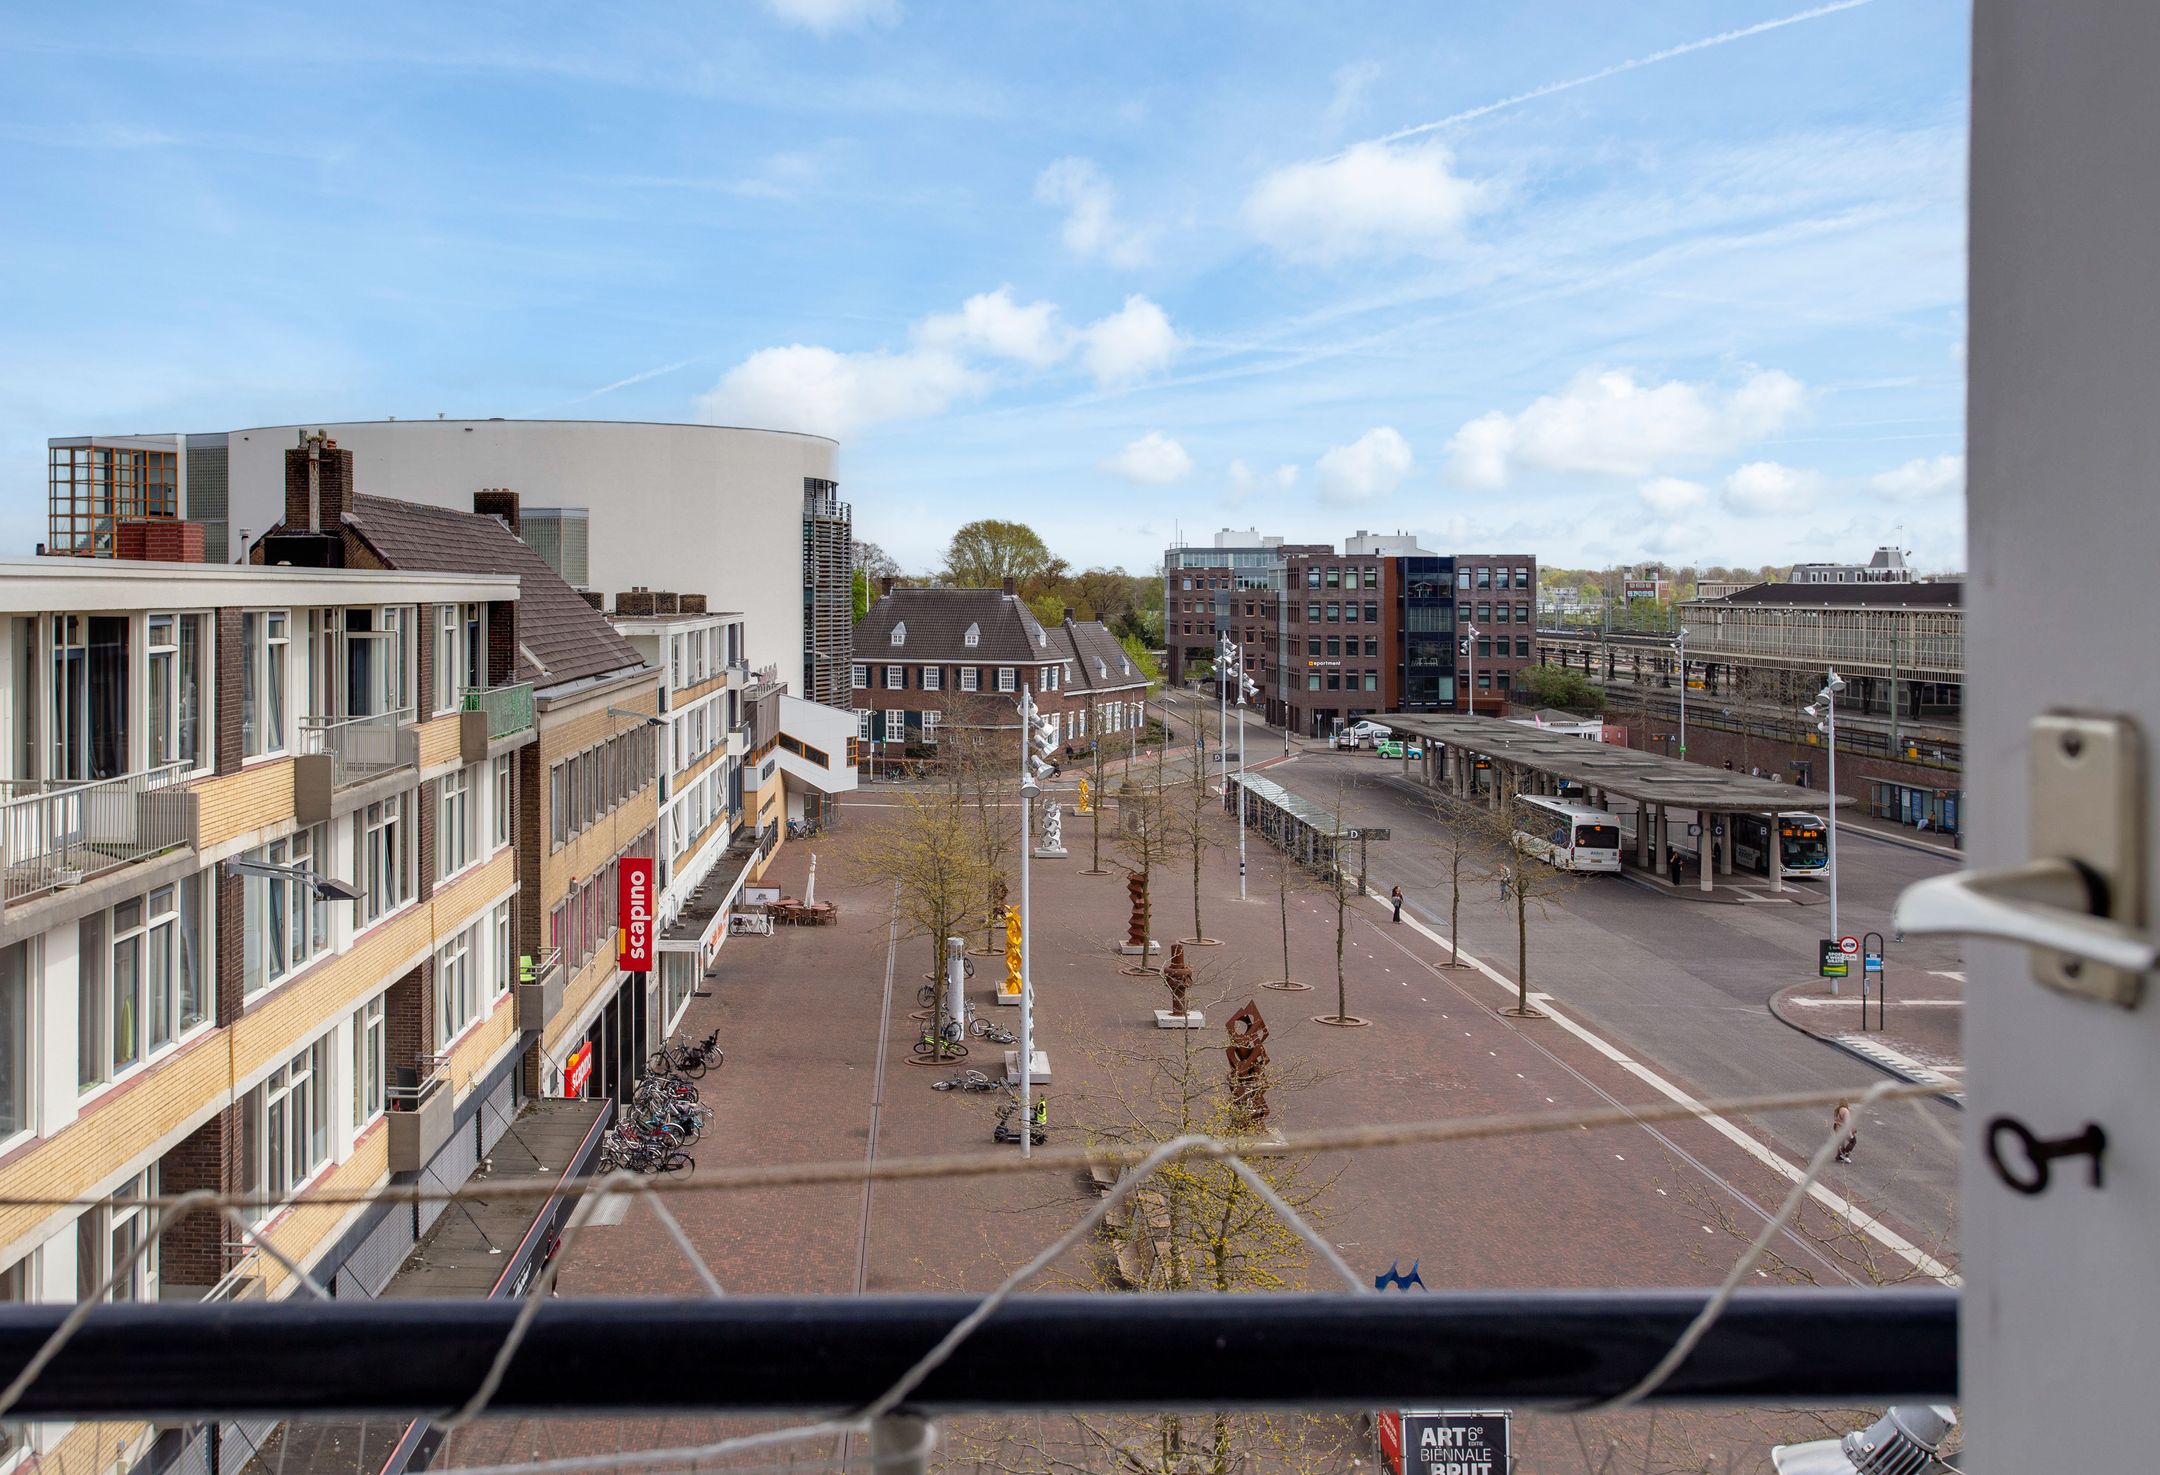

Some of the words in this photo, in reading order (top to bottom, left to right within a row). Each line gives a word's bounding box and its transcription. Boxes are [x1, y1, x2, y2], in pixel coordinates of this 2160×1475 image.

[1350, 830, 1358, 839] D
[1715, 826, 1722, 835] C
[1760, 827, 1767, 836] B
[630, 870, 652, 959] scapino
[1421, 1427, 1466, 1447] ART
[1420, 1446, 1492, 1462] BIËNNALE
[1430, 1463, 1492, 1475] BRUT
